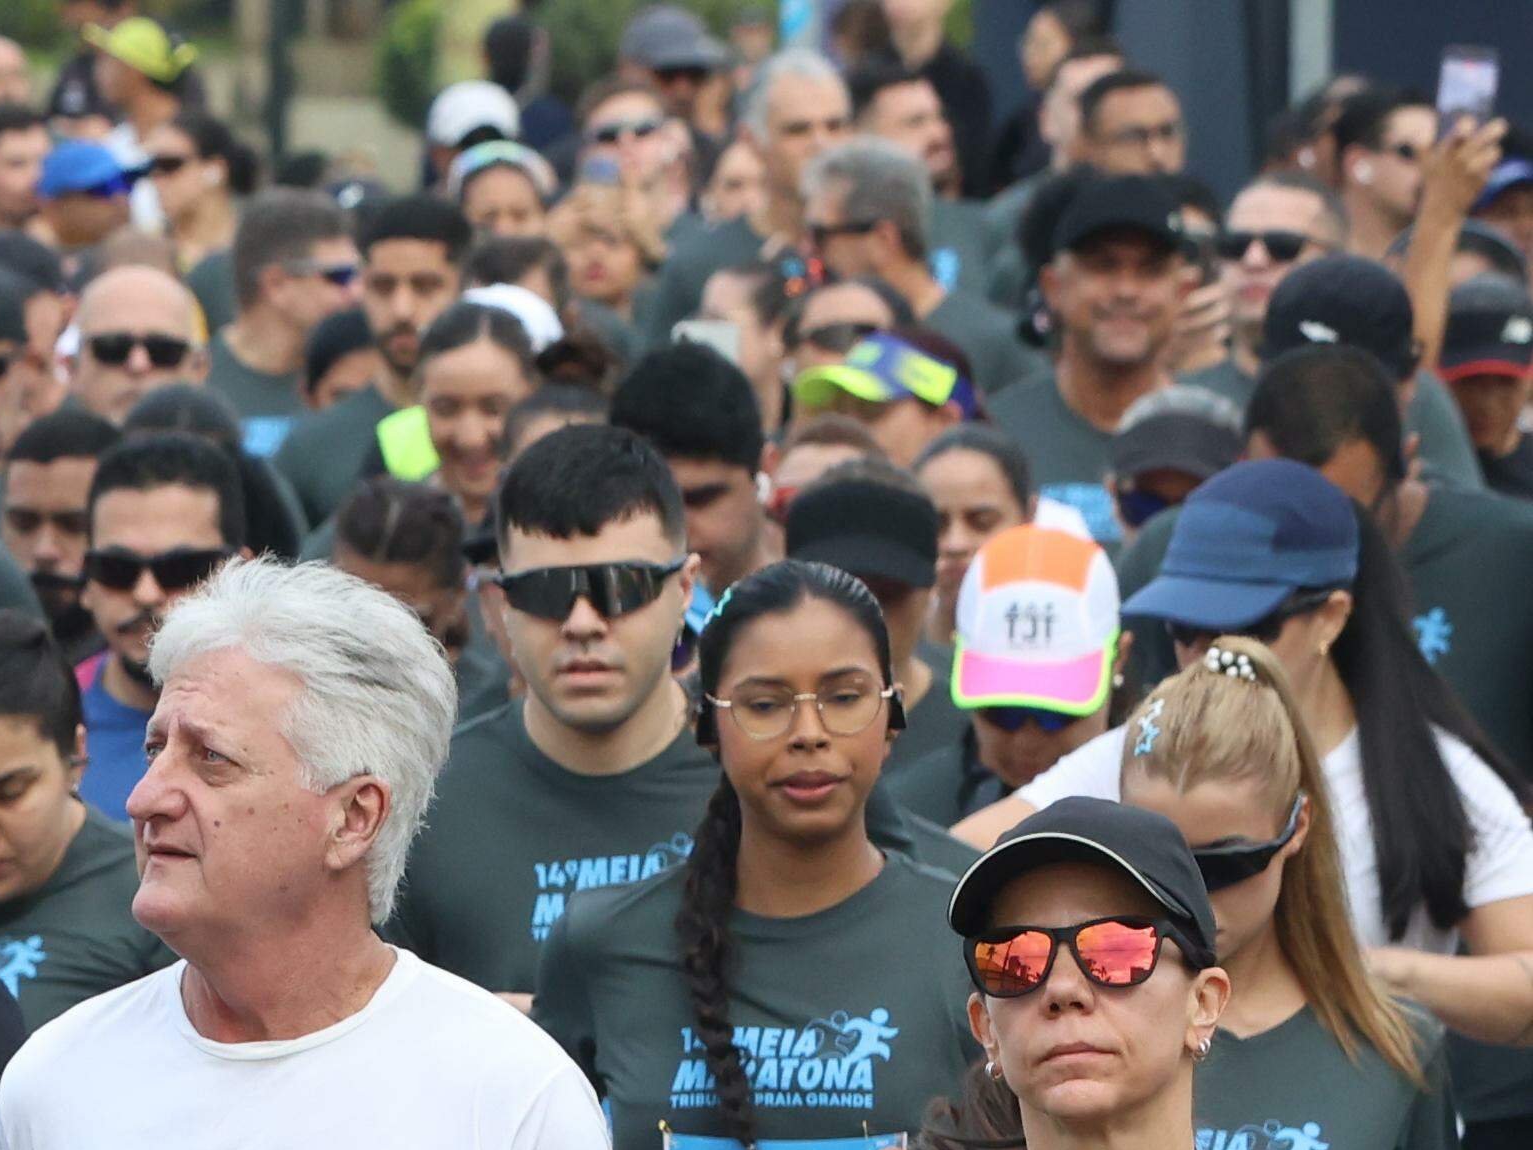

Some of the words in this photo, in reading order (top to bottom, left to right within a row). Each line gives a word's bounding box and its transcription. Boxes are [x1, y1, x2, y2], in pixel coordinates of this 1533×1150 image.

[576, 853, 664, 891] MEIA
[755, 1093, 803, 1107] PRAIA
[805, 1093, 874, 1109] GRANDE
